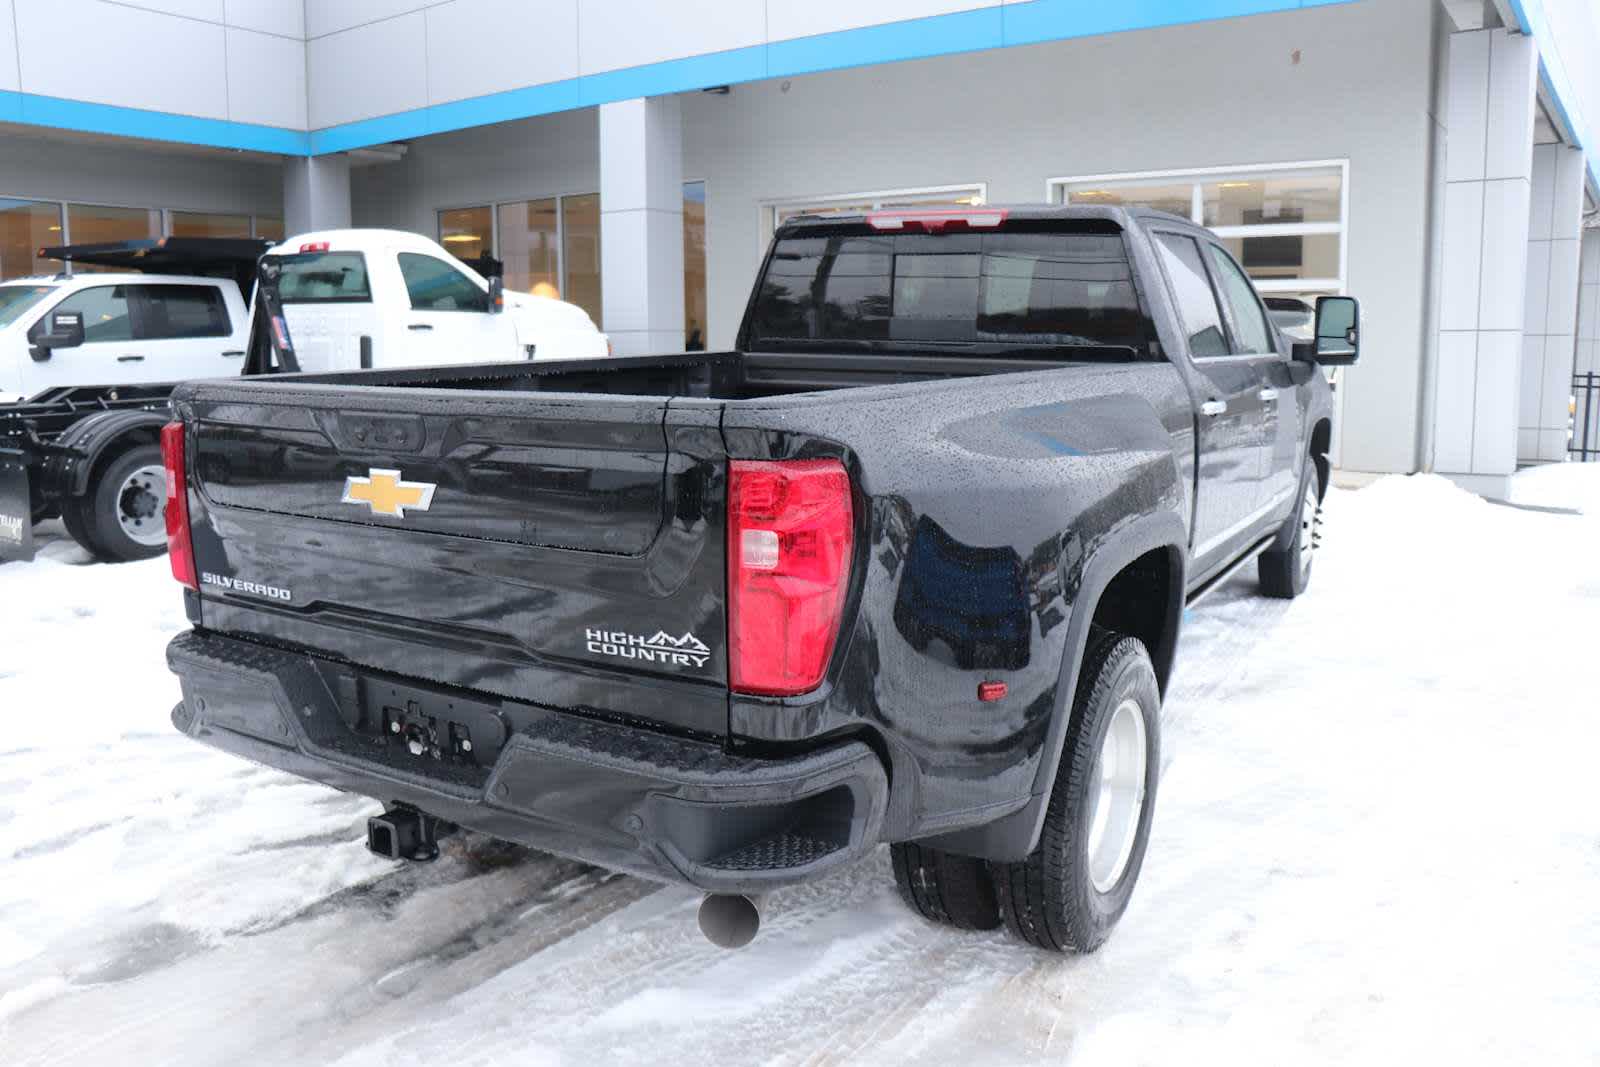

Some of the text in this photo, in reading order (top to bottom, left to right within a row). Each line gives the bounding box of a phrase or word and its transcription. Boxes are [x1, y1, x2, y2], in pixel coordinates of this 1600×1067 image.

[202, 572, 291, 600] SILVERADO
[586, 629, 645, 647] HIGH
[587, 641, 710, 667] COUNTRY
